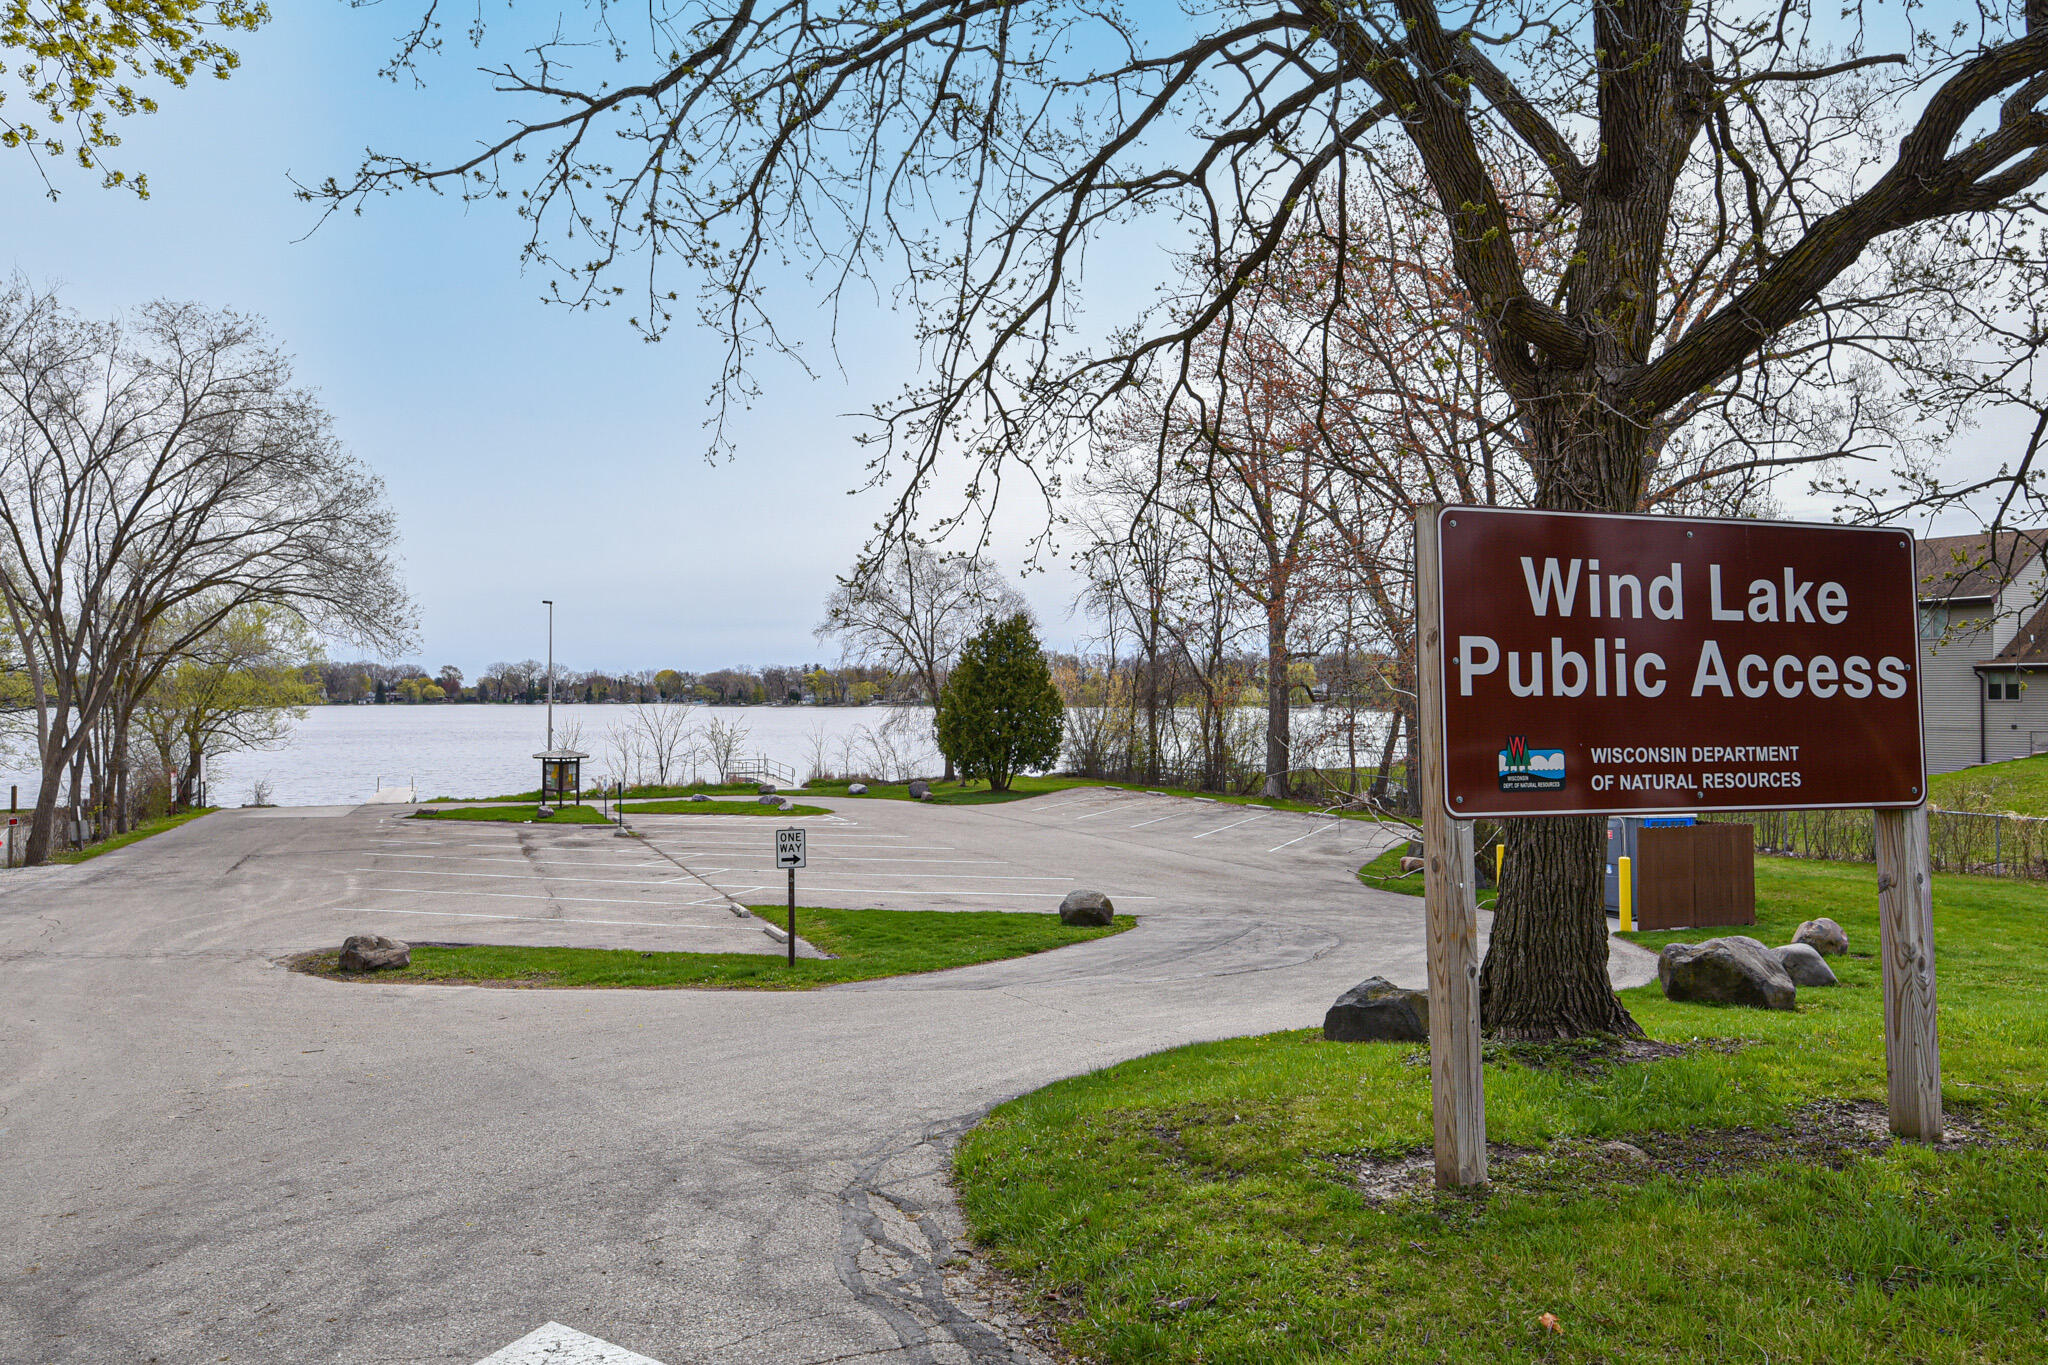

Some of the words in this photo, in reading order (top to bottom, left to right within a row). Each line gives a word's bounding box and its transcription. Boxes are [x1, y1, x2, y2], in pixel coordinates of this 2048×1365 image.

[1519, 556, 1684, 621] Wind
[1709, 564, 1849, 625] Lake
[1459, 635, 1667, 698] Public
[1690, 640, 1907, 699] Access
[1590, 746, 1687, 764] WISCONSIN
[1691, 745, 1800, 763] DEPARTMENT
[1591, 774, 1615, 791] OF
[1619, 773, 1698, 791] NATURAL
[1702, 771, 1802, 789] RESOURCES
[780, 832, 802, 842] ONE
[779, 843, 802, 853] WAY
